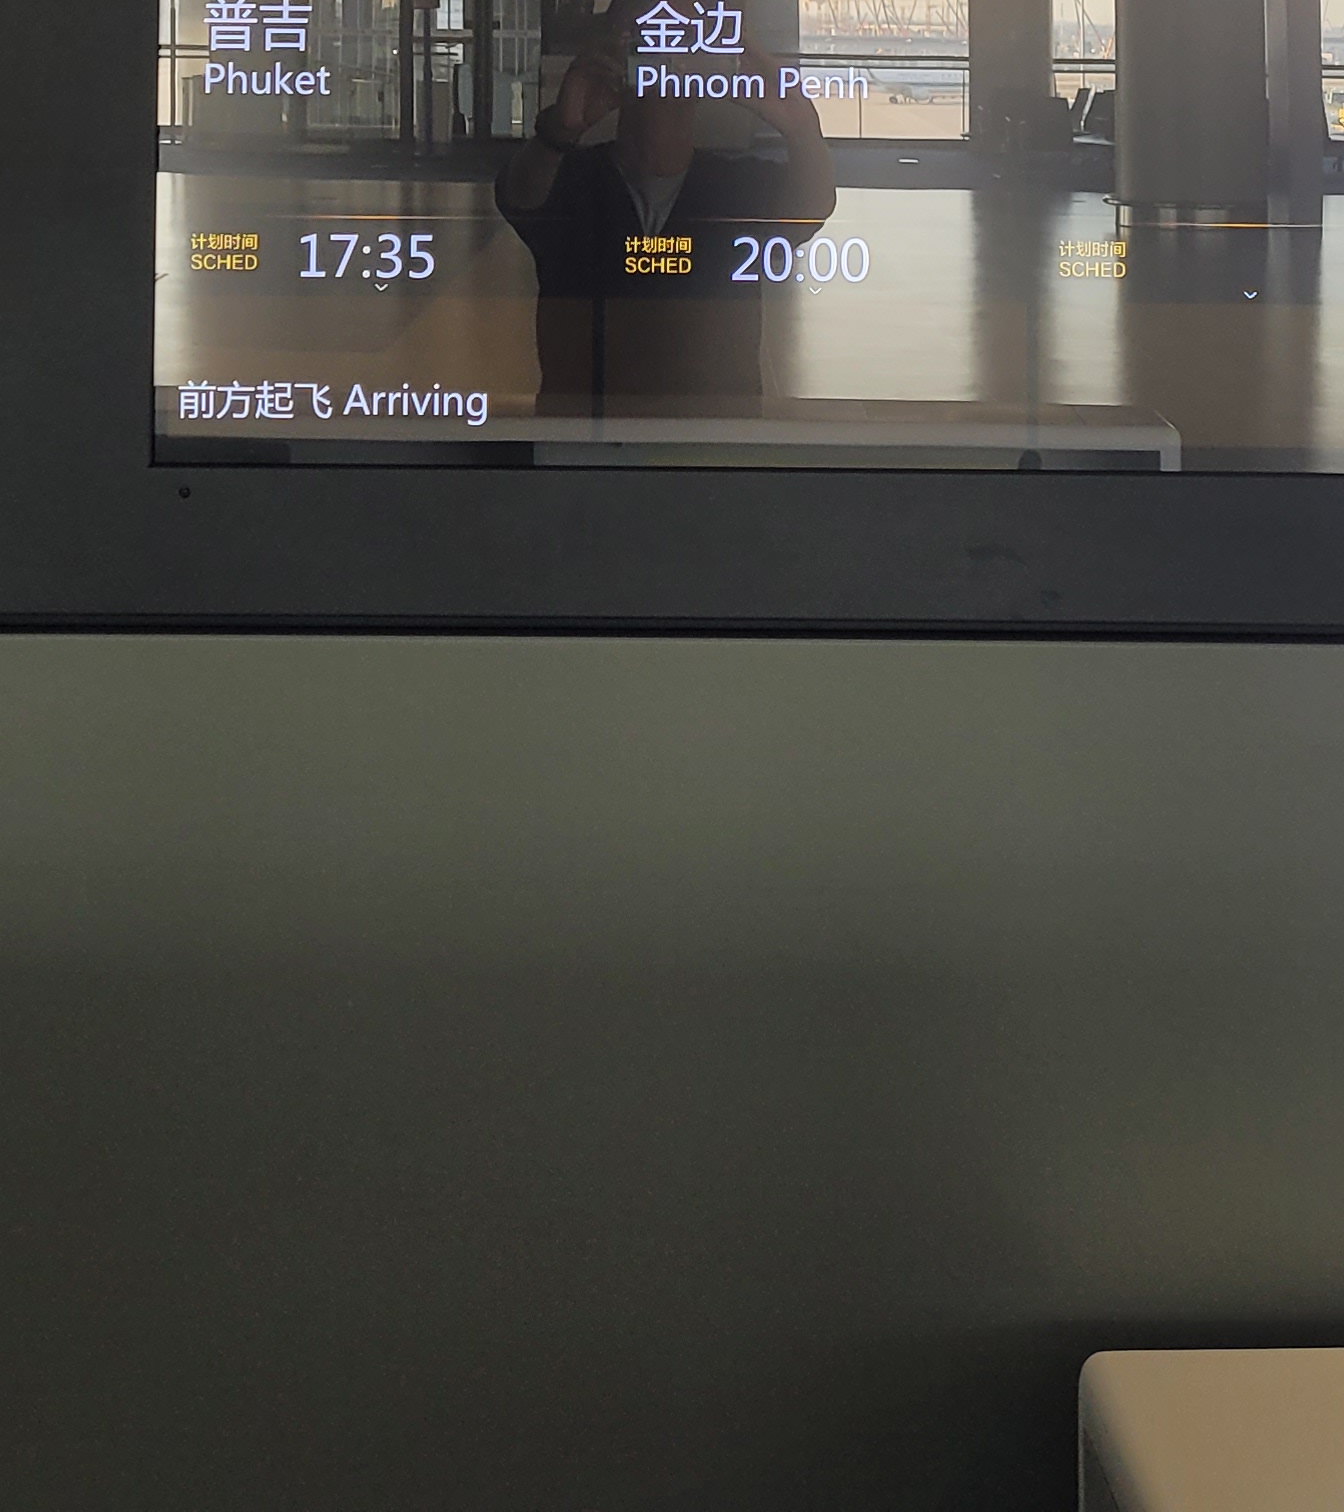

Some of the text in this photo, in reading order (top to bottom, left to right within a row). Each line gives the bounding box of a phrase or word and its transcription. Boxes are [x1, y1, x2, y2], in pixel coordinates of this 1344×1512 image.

[636, 1, 744, 54] 金边
[204, 62, 331, 95] Phuket
[637, 65, 869, 99] Phnom Penh
[190, 233, 259, 251] 计划时间
[624, 235, 692, 254] 计划时间
[1058, 239, 1127, 258] 计划时间
[190, 254, 259, 271] SCHED
[299, 233, 436, 280] 17:35
[624, 256, 692, 275] SCHED
[730, 236, 871, 283] 20:00
[1058, 259, 1127, 279] SCHED
[178, 380, 489, 425] 前方起飞 Arriving
